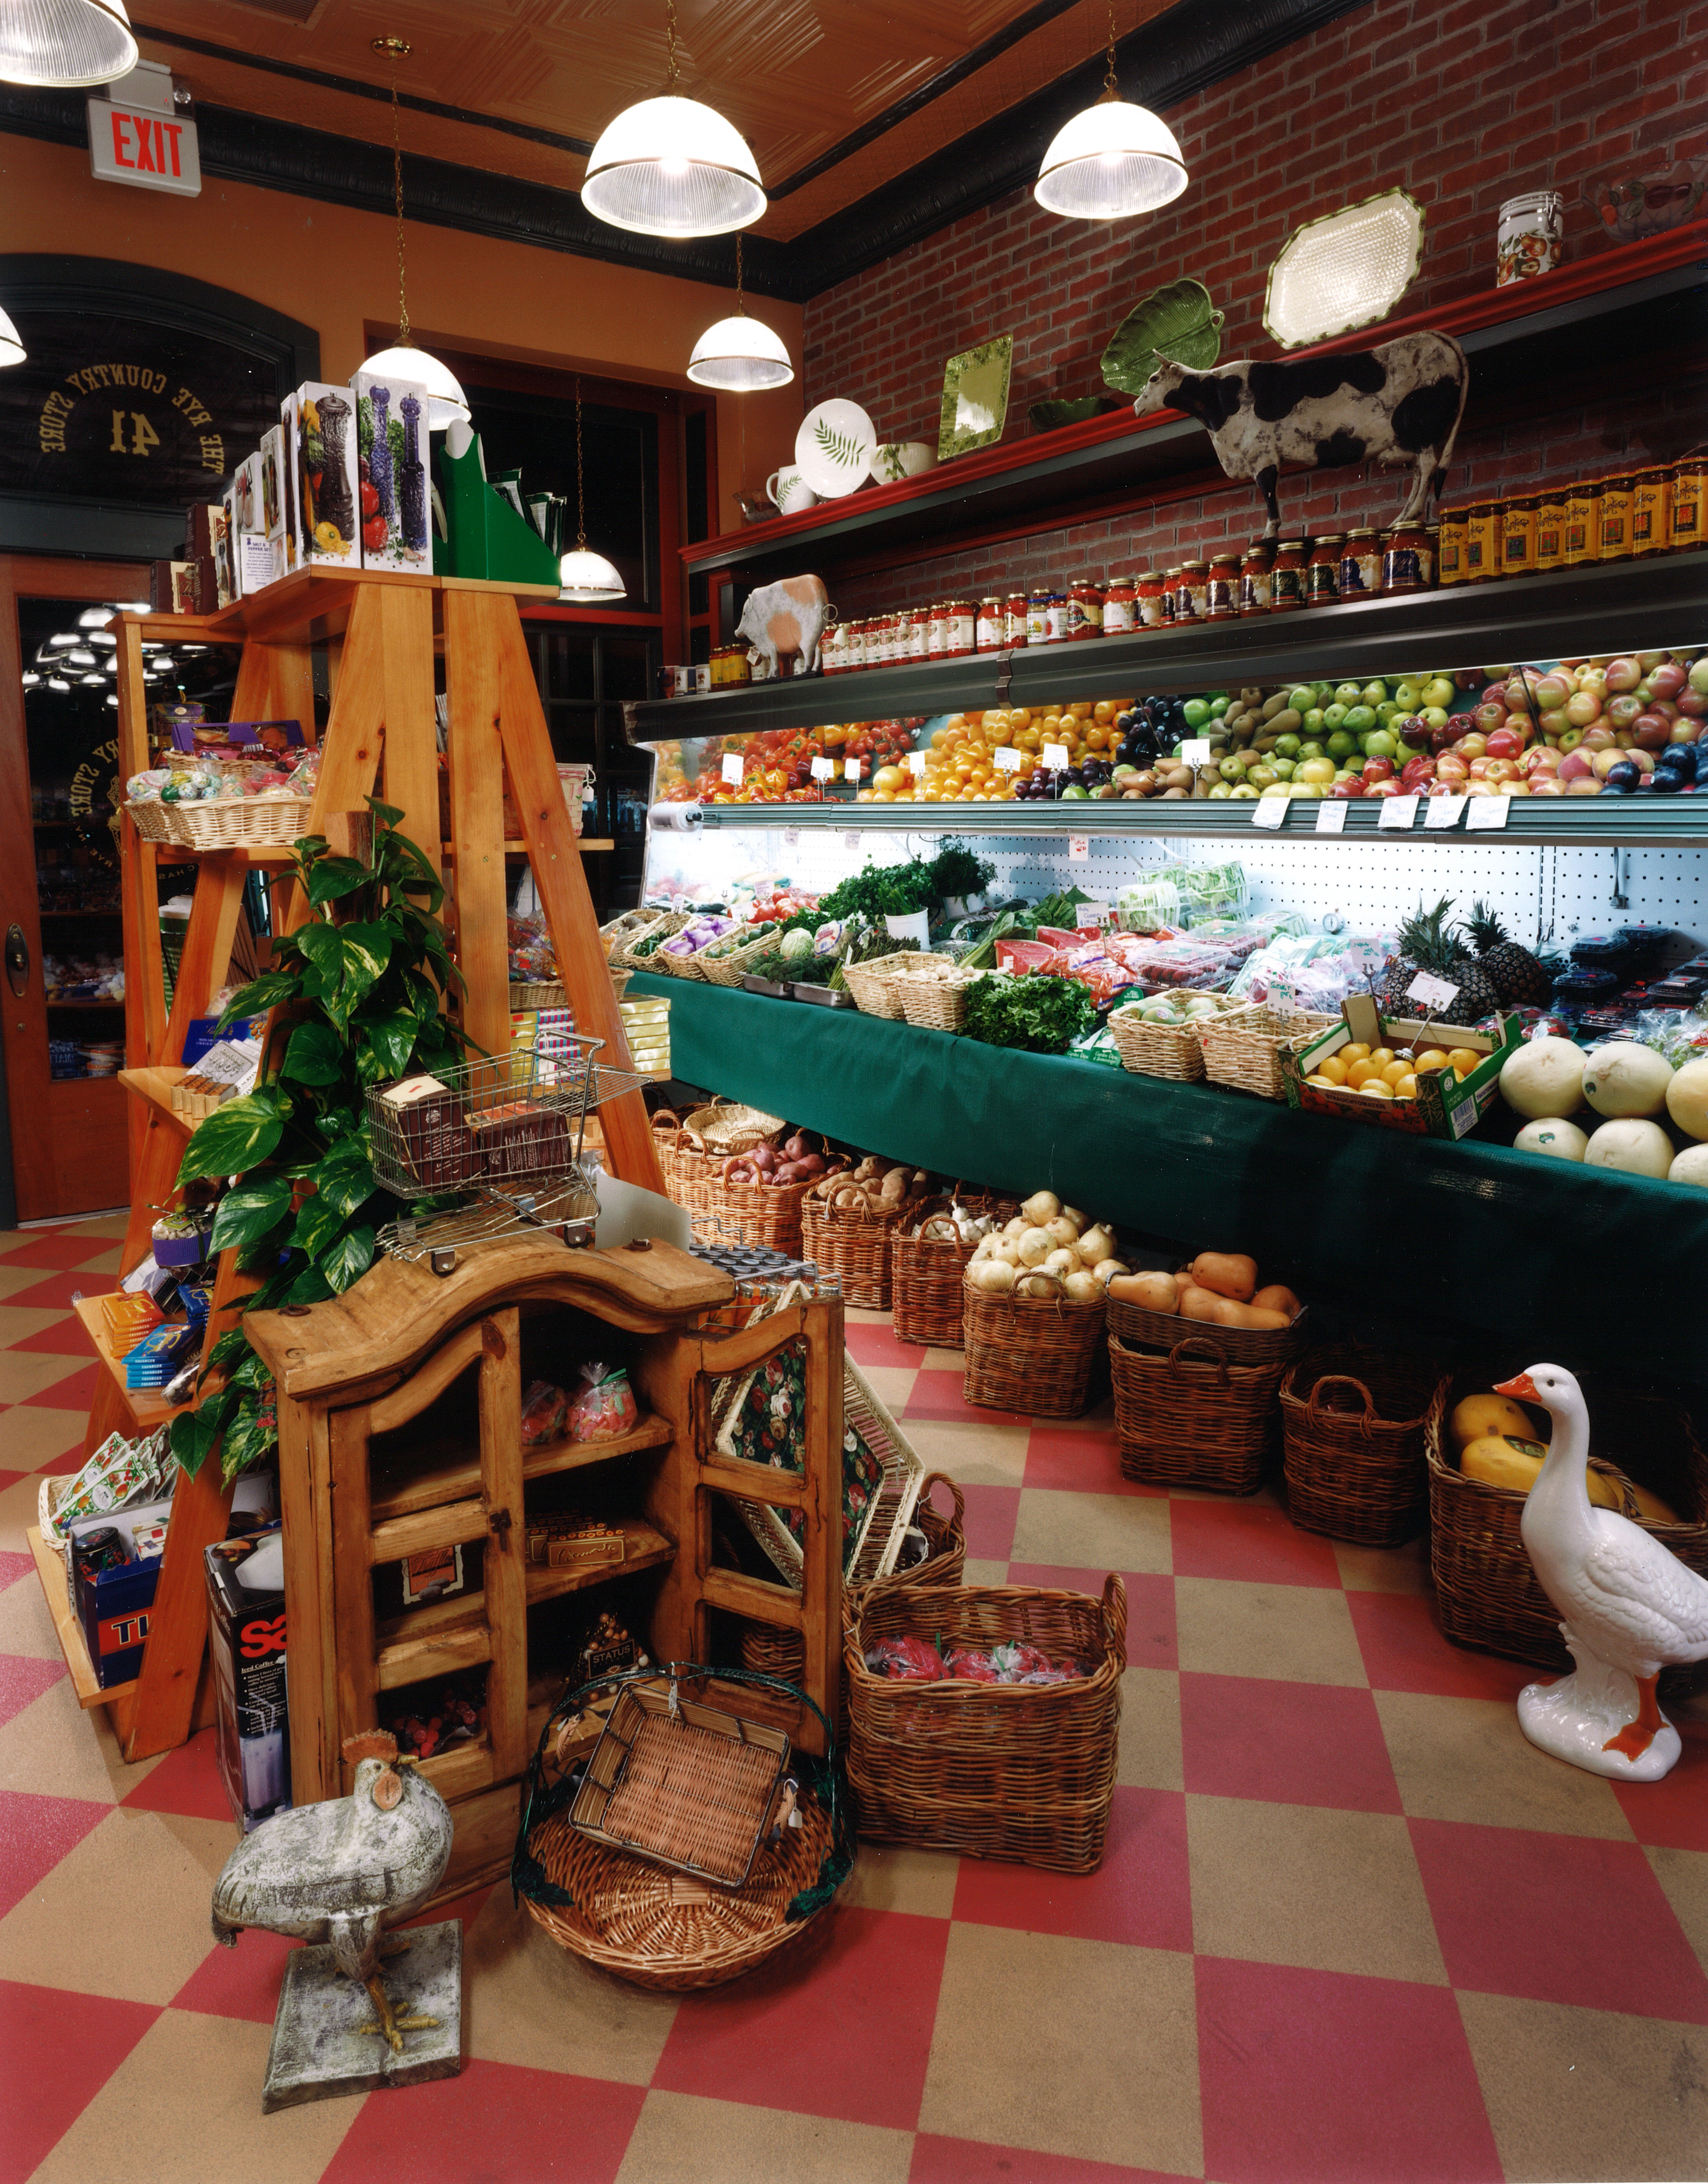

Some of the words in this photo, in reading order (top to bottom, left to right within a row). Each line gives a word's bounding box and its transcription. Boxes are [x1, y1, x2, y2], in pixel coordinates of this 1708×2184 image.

[112, 111, 182, 177] EXIT
[1325, 1093, 1386, 1109] STRAUCHTOMATEN
[593, 1645, 630, 1663] STATUS
